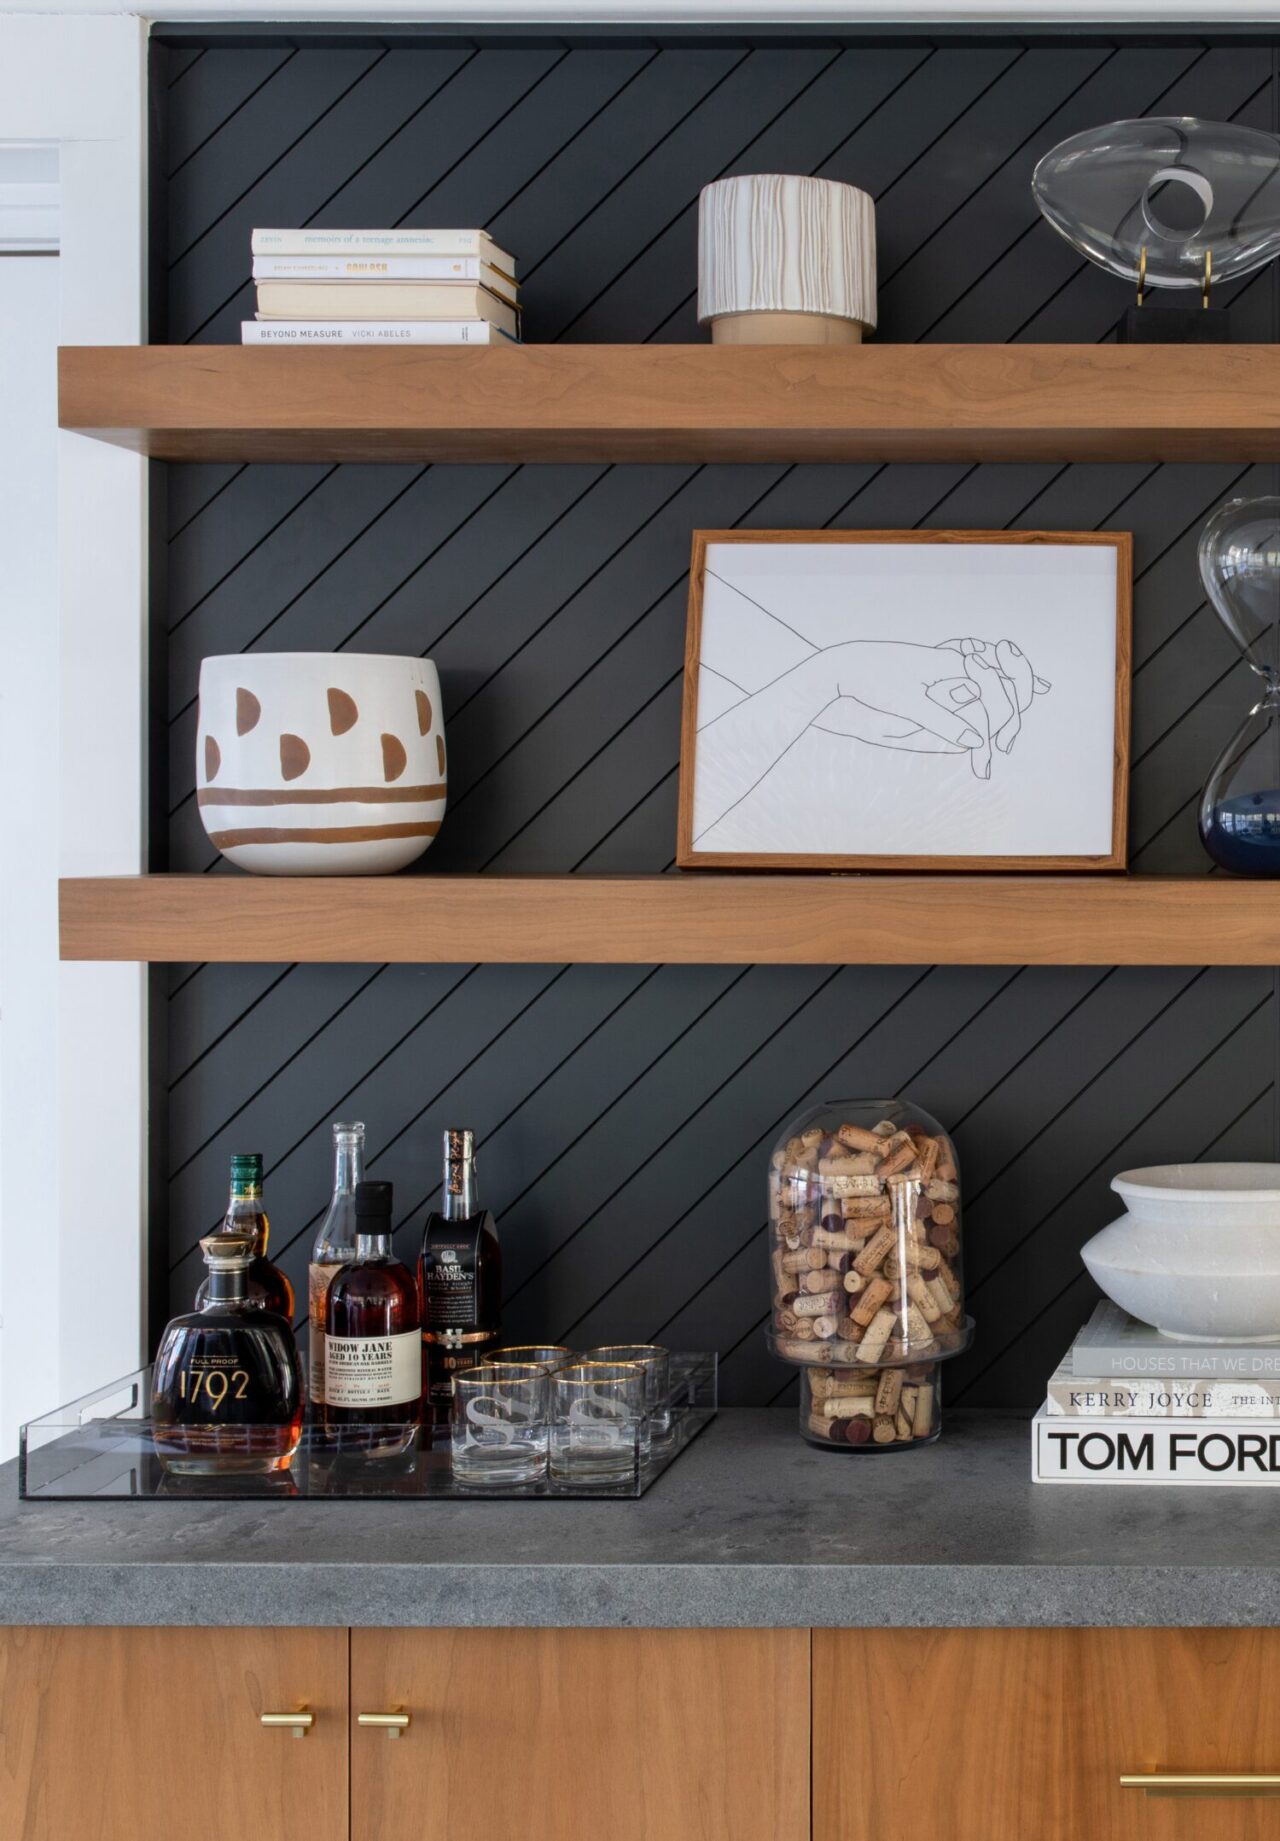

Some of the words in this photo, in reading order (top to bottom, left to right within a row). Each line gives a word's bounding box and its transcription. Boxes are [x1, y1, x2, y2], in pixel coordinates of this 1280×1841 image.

[304, 234, 342, 244] memoirs
[343, 233, 353, 244] of
[362, 235, 394, 246] teenage
[260, 329, 297, 339] BEYOND
[300, 329, 343, 339] MEASURE
[352, 329, 375, 339] VICKI
[378, 329, 412, 339] ABELES
[435, 1264, 464, 1273] BASIL
[427, 1272, 475, 1281] HAYDEN'S
[329, 1341, 358, 1353] WIDOW
[362, 1341, 392, 1352] JANE
[329, 1352, 345, 1360] AGED
[348, 1353, 359, 1361] 10
[361, 1352, 392, 1361] YEARS
[443, 1356, 456, 1369] 10
[1112, 1356, 1175, 1372] HOUSES
[1179, 1357, 1219, 1372] THAT
[1223, 1357, 1248, 1371] WE
[179, 1370, 250, 1411] 1792
[1069, 1392, 1138, 1408] KERRY
[1148, 1393, 1212, 1408] JOYCE
[1232, 1395, 1256, 1406] THE
[466, 1396, 516, 1450] S
[1048, 1432, 1154, 1471] TOM
